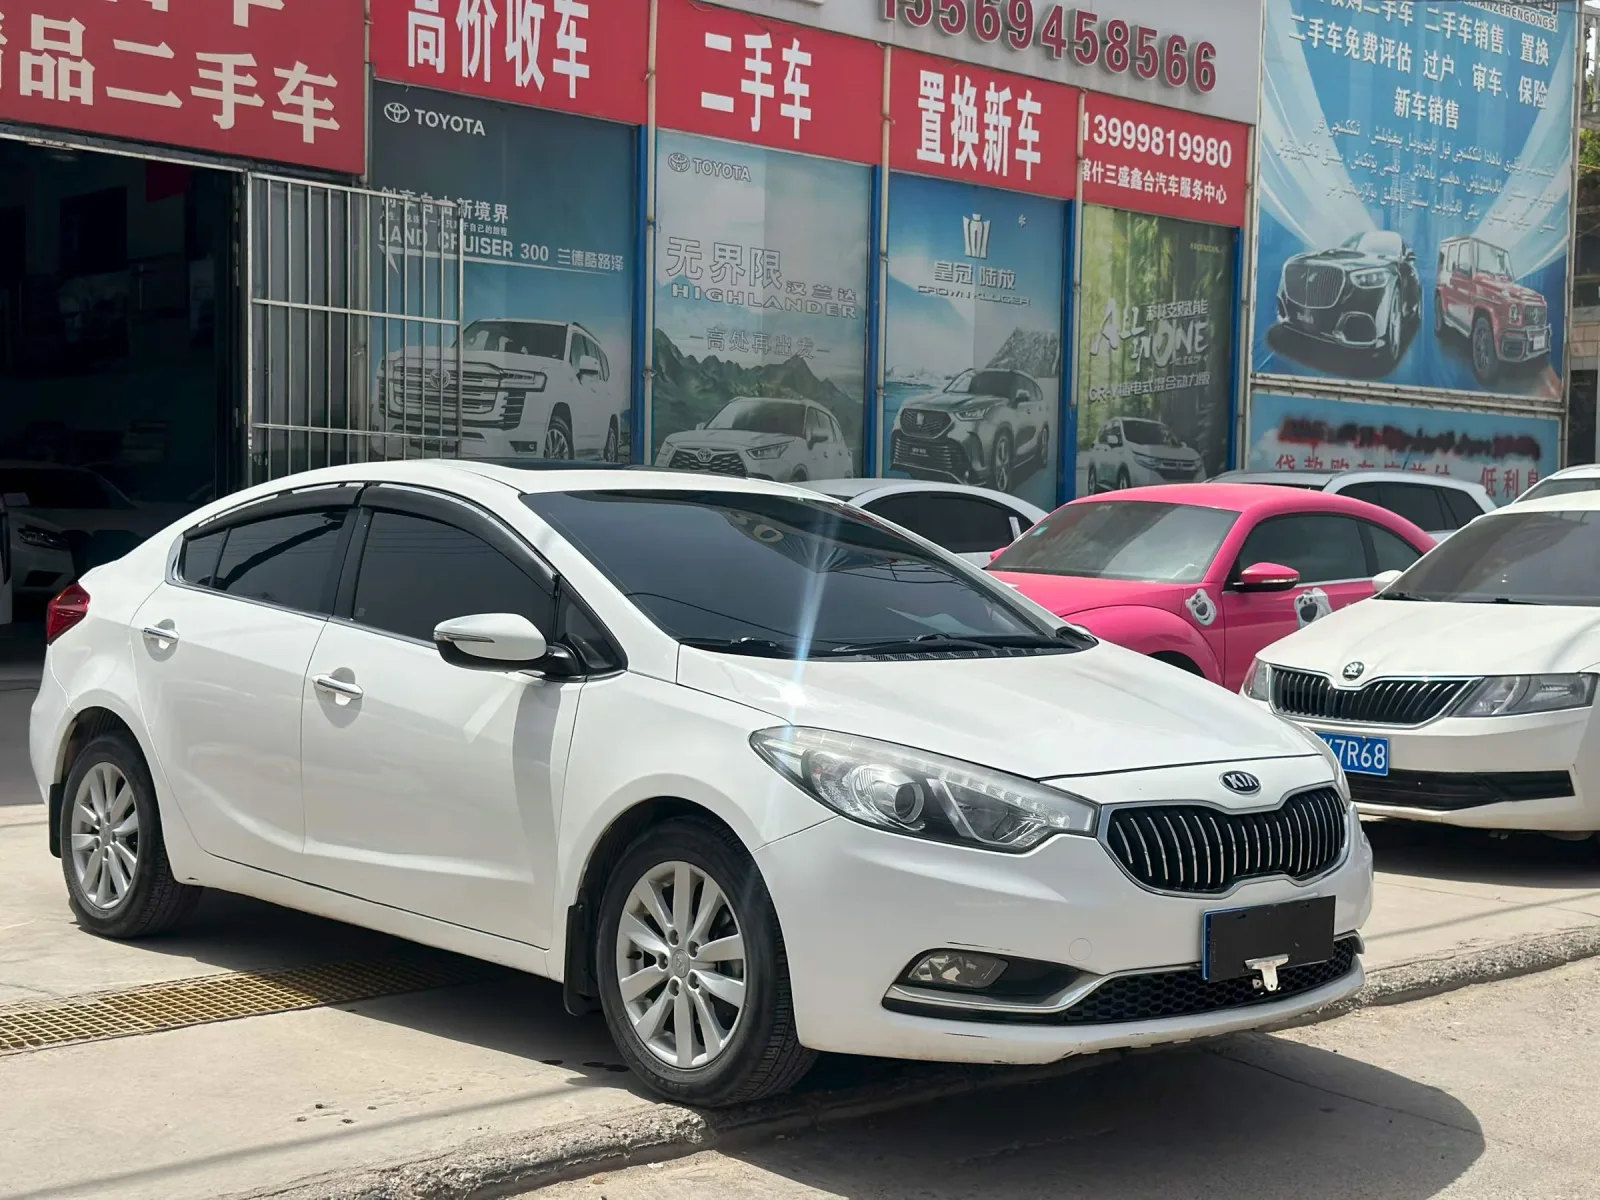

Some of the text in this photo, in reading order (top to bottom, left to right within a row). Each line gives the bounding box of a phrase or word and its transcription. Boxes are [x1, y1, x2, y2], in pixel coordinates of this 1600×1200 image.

[407, 0, 590, 98] 高价收车
[1288, 14, 1413, 73] 二手车免费评估
[1518, 75, 1549, 109] 保险
[1520, 32, 1549, 68] 置换
[0, 12, 341, 144] 品二手车
[700, 32, 812, 140] 二手车
[414, 108, 486, 137] TOYOTA
[916, 69, 1042, 181] 置换新车
[1393, 86, 1460, 130] 新车销售
[1082, 112, 1231, 169] 13999819980
[692, 158, 751, 182] TOYOTA
[379, 225, 428, 248] LAND
[520, 243, 549, 262] 300
[666, 237, 782, 289] 无界限
[671, 283, 858, 319] HIGHLANDER
[1323, 737, 1386, 770] 7R68
[1224, 773, 1258, 789] KIA
